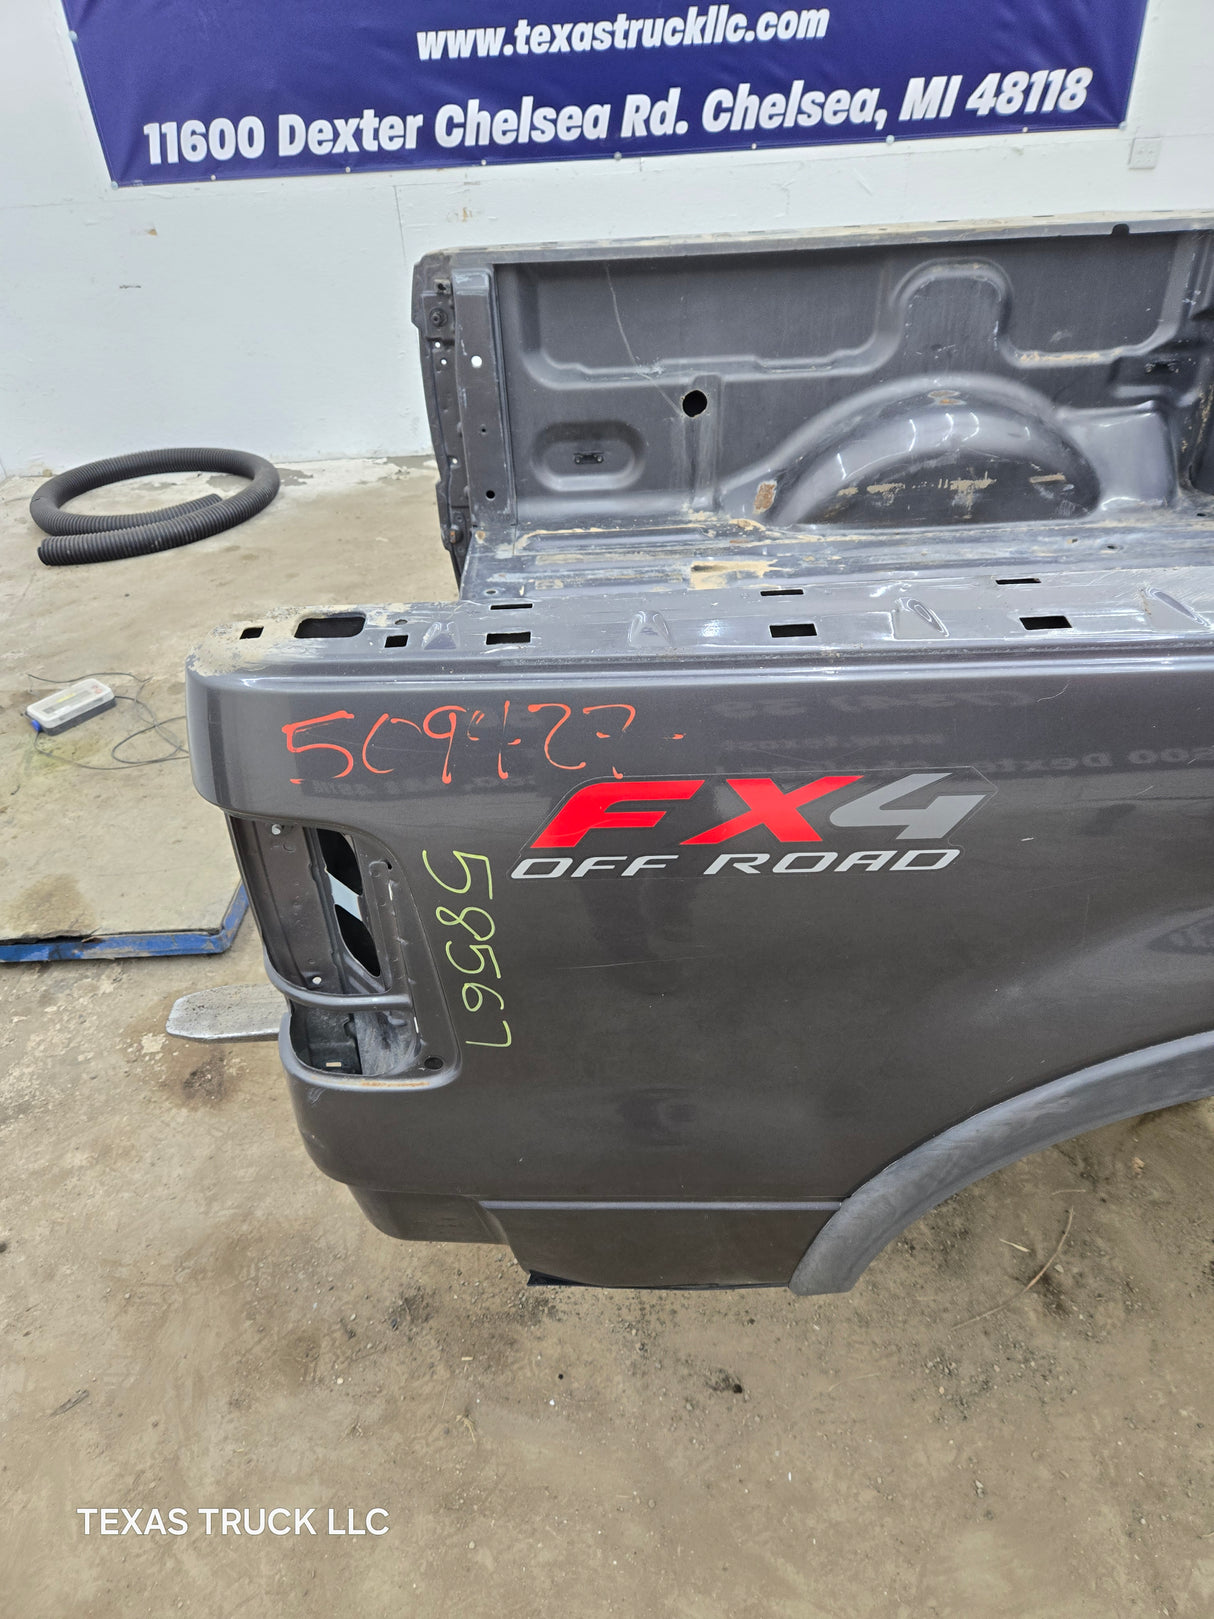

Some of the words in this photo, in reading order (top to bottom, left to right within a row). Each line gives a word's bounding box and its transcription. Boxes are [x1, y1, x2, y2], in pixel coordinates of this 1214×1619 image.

[416, 5, 831, 61] www.texastruckllc.com
[143, 115, 265, 165] 11600
[278, 109, 425, 157] Dexter
[434, 95, 611, 148] Chelsea
[620, 88, 690, 138] Rd.
[702, 79, 888, 132] Chelsea,
[898, 75, 963, 121] MI
[965, 67, 1093, 115] 48118
[529, 772, 988, 849] FX4
[510, 855, 679, 880] OFF
[703, 847, 961, 876] ROAD
[421, 849, 512, 1048] 58567
